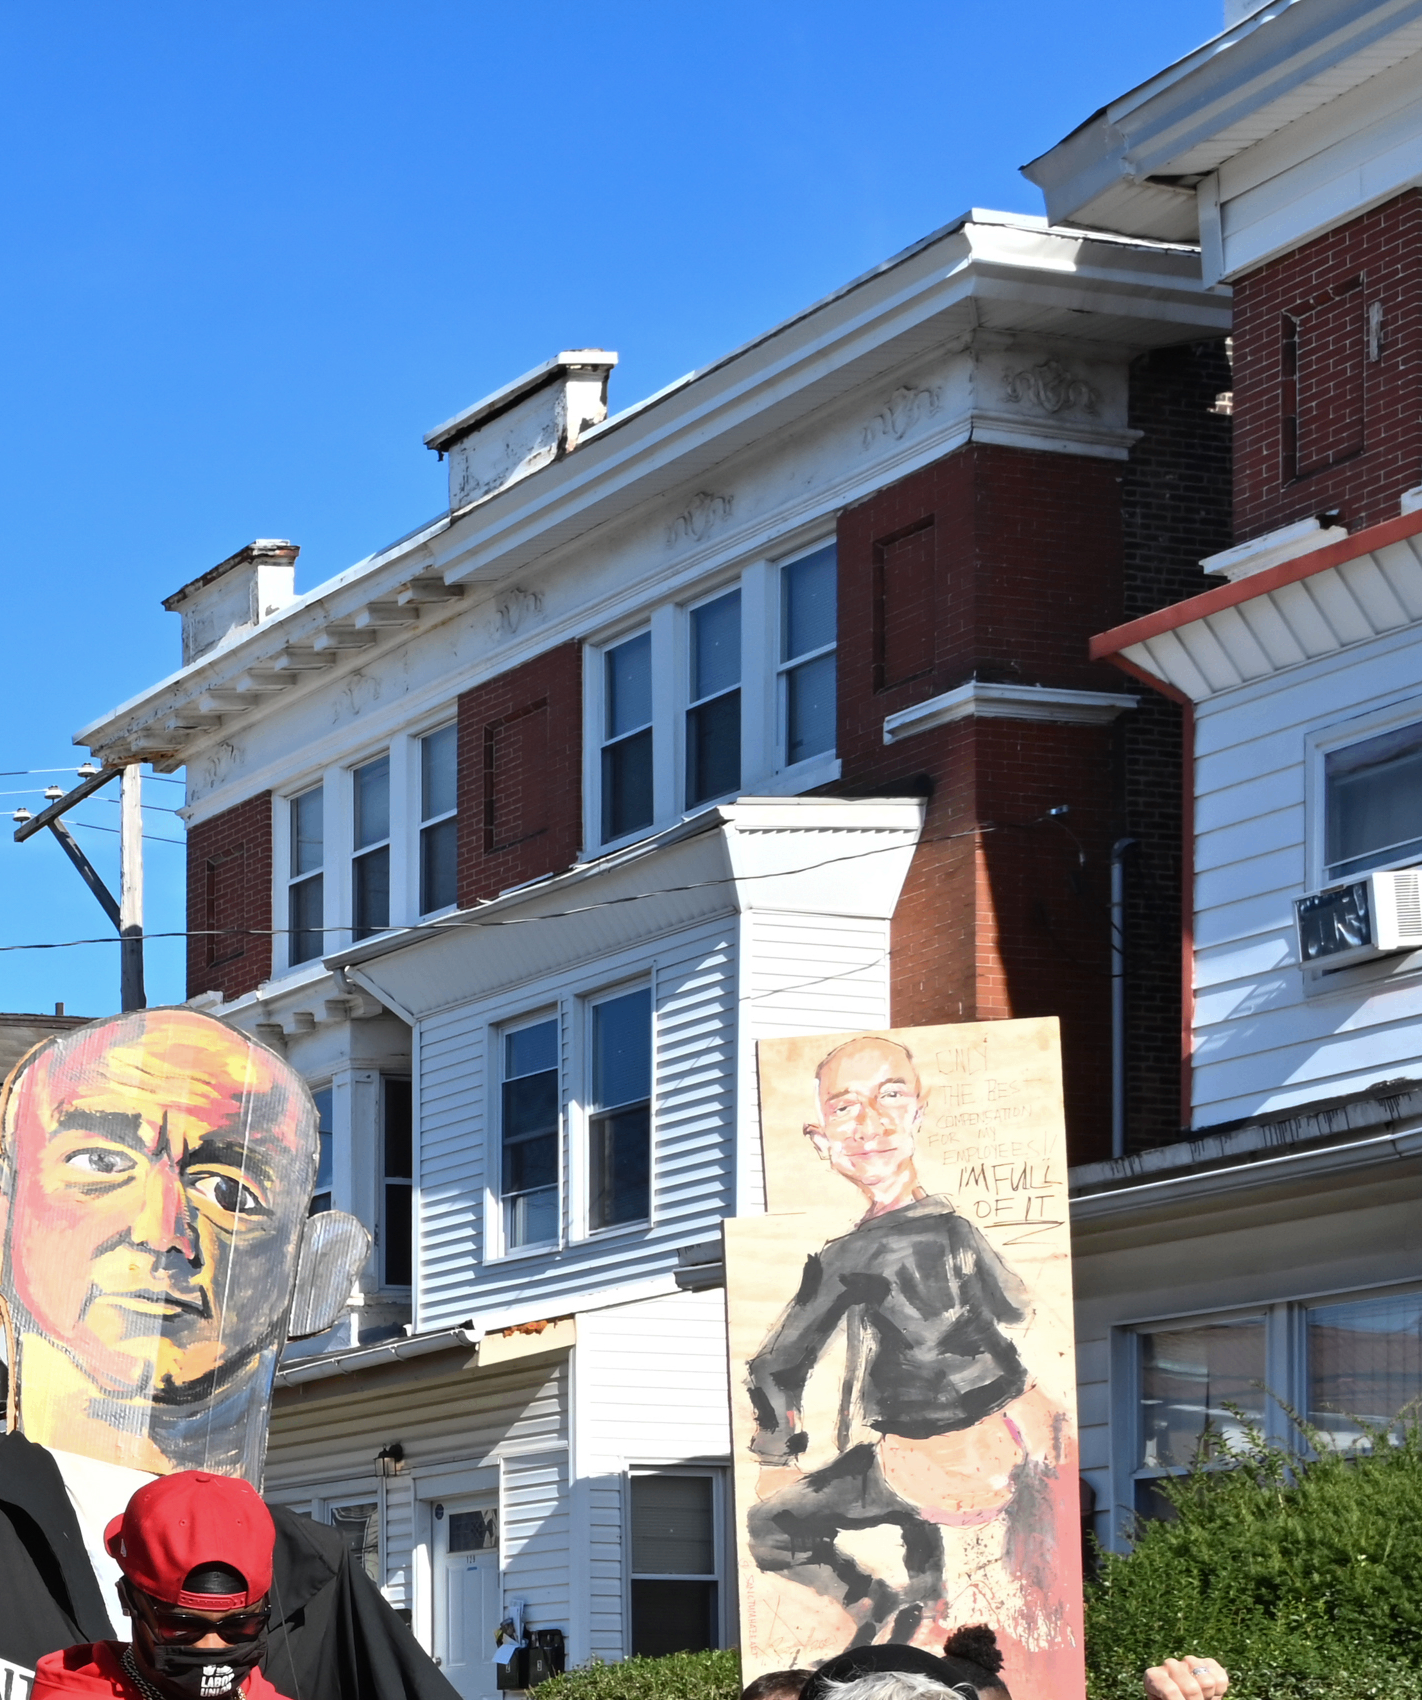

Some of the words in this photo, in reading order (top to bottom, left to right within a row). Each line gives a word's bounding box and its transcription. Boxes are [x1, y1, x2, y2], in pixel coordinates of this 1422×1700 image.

[940, 1084, 975, 1105] THE
[936, 1105, 1032, 1130] COMPENSATION
[927, 1132, 960, 1148] FOR
[978, 1127, 996, 1142] MY
[958, 1162, 990, 1194] I'M
[991, 1161, 1063, 1195] FULL
[973, 1197, 1015, 1219] OF
[1024, 1194, 1055, 1222] IT
[200, 1682, 232, 1697] UNION
